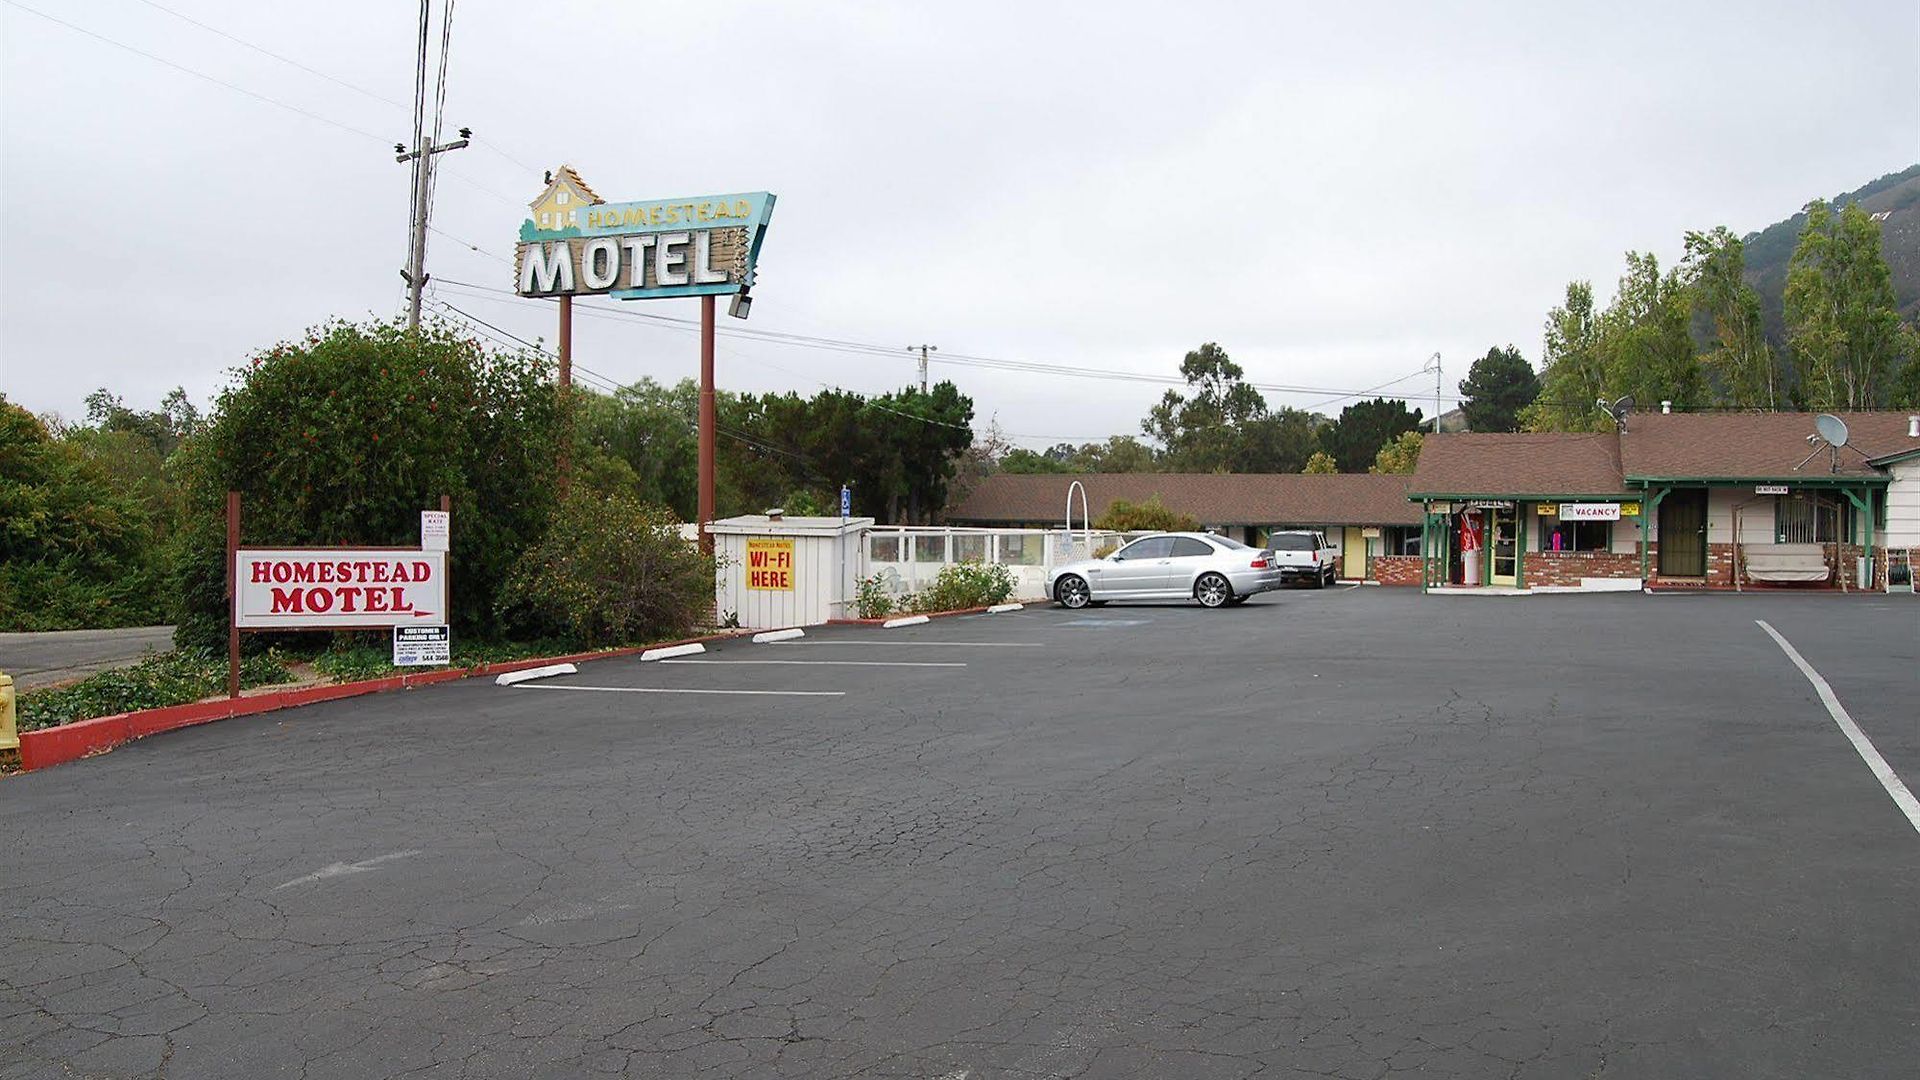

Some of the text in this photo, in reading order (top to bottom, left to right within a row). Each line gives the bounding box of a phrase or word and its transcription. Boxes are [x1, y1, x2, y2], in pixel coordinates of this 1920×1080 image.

[588, 198, 752, 229] HOMESTEAD
[520, 229, 729, 293] MOTEL
[1576, 508, 1617, 516] VACANCY
[750, 551, 790, 568] WI-FI
[251, 561, 431, 583] HOMESTEAD
[751, 571, 789, 588] HERE
[270, 587, 414, 614] MOTEL
